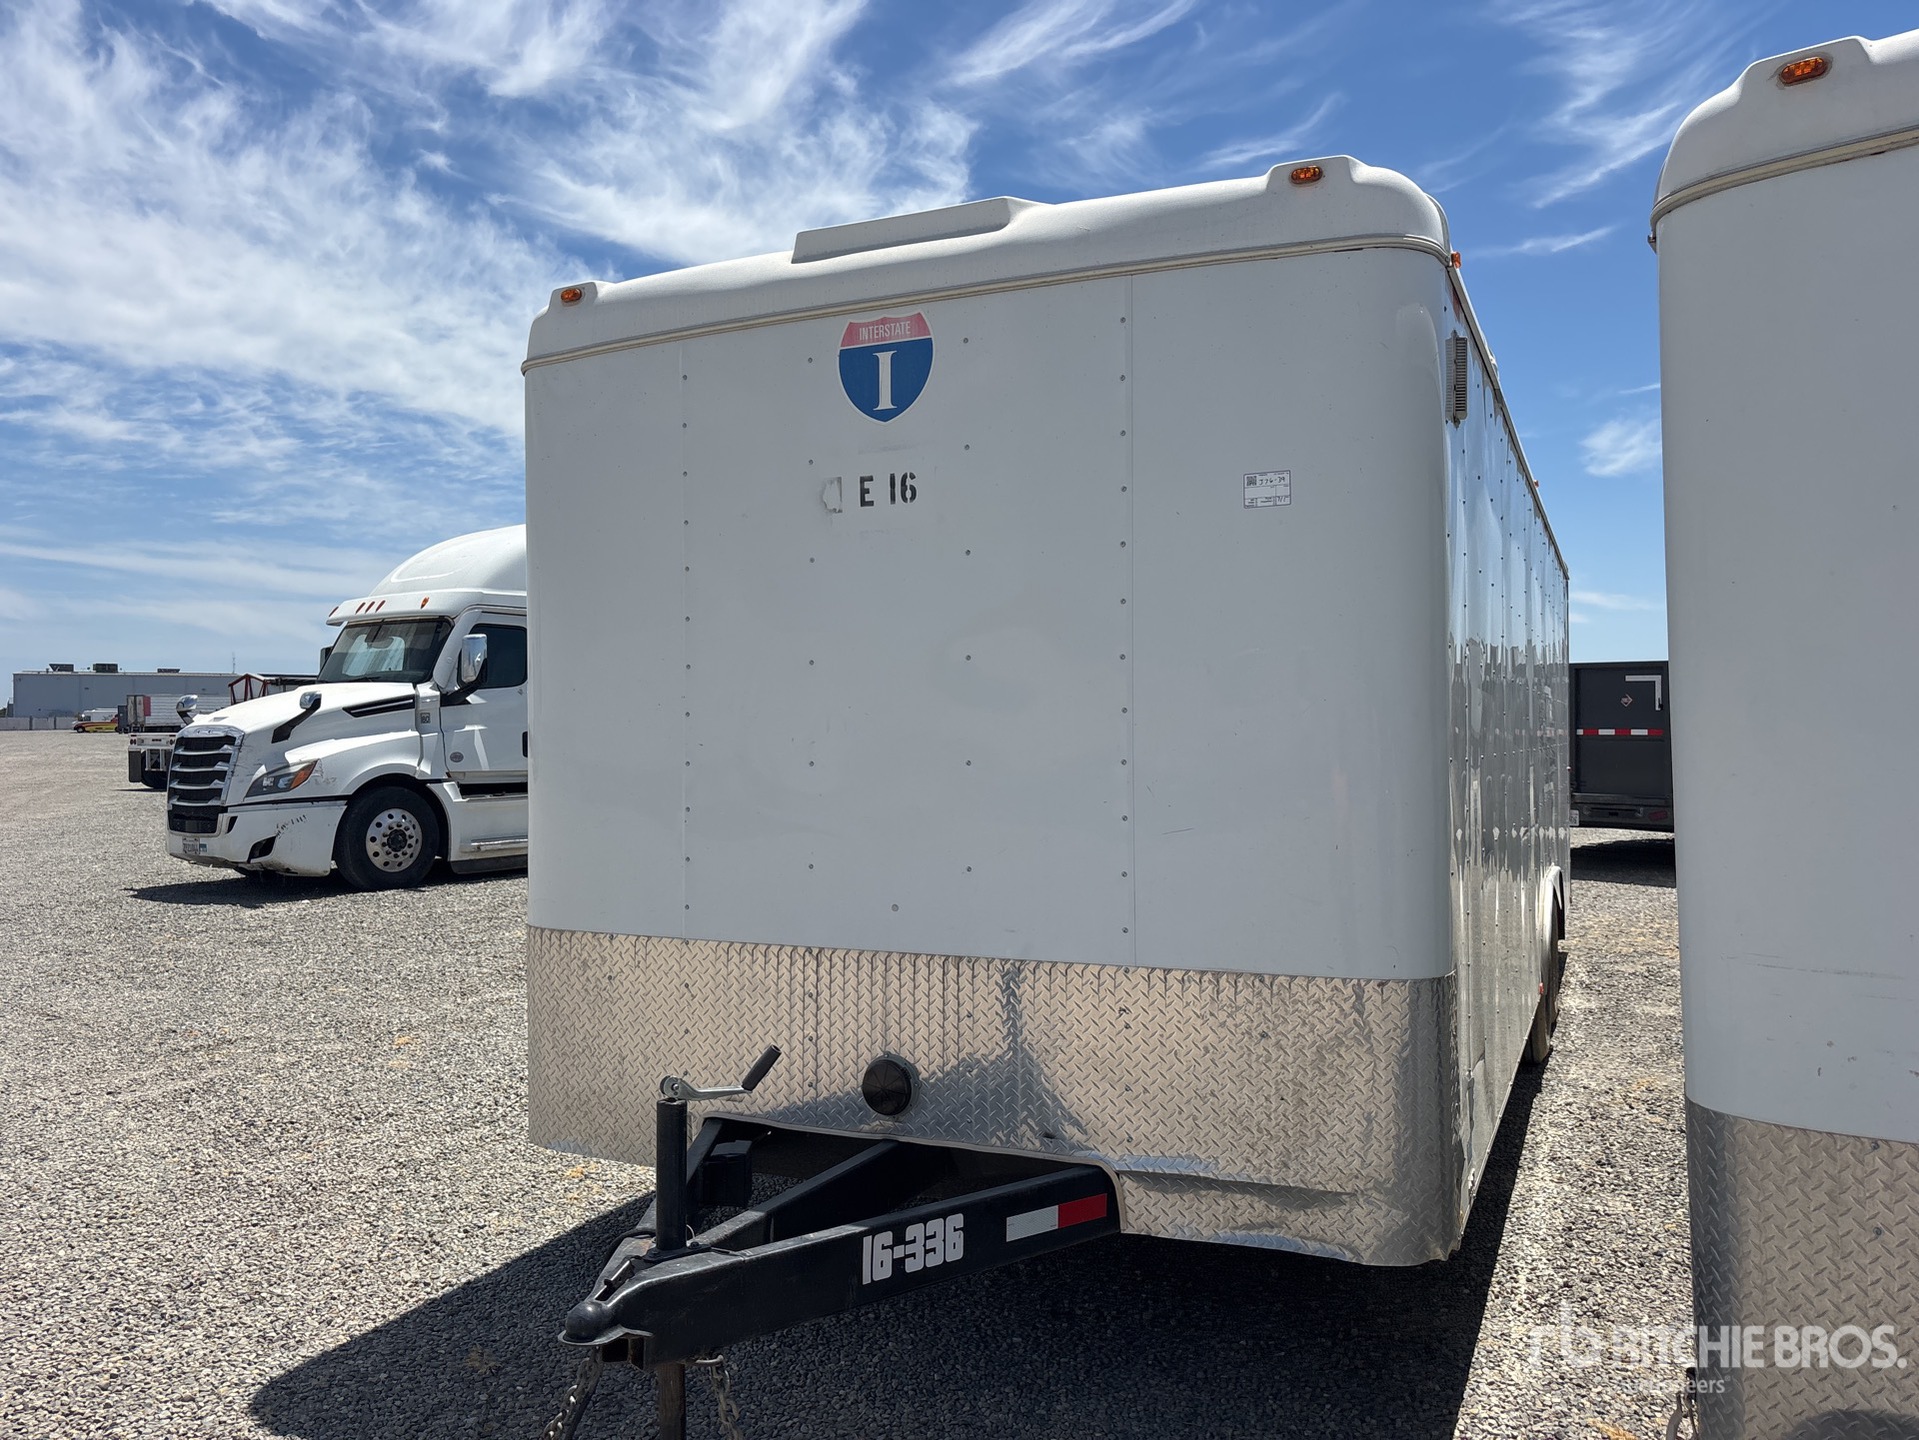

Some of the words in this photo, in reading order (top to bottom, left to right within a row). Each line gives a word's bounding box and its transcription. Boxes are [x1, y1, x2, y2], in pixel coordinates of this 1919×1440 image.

[858, 320, 912, 342] INTERSTATE
[872, 350, 898, 412] I
[859, 474, 875, 508] E
[889, 471, 918, 505] 16
[861, 1212, 965, 1286] 16-336
